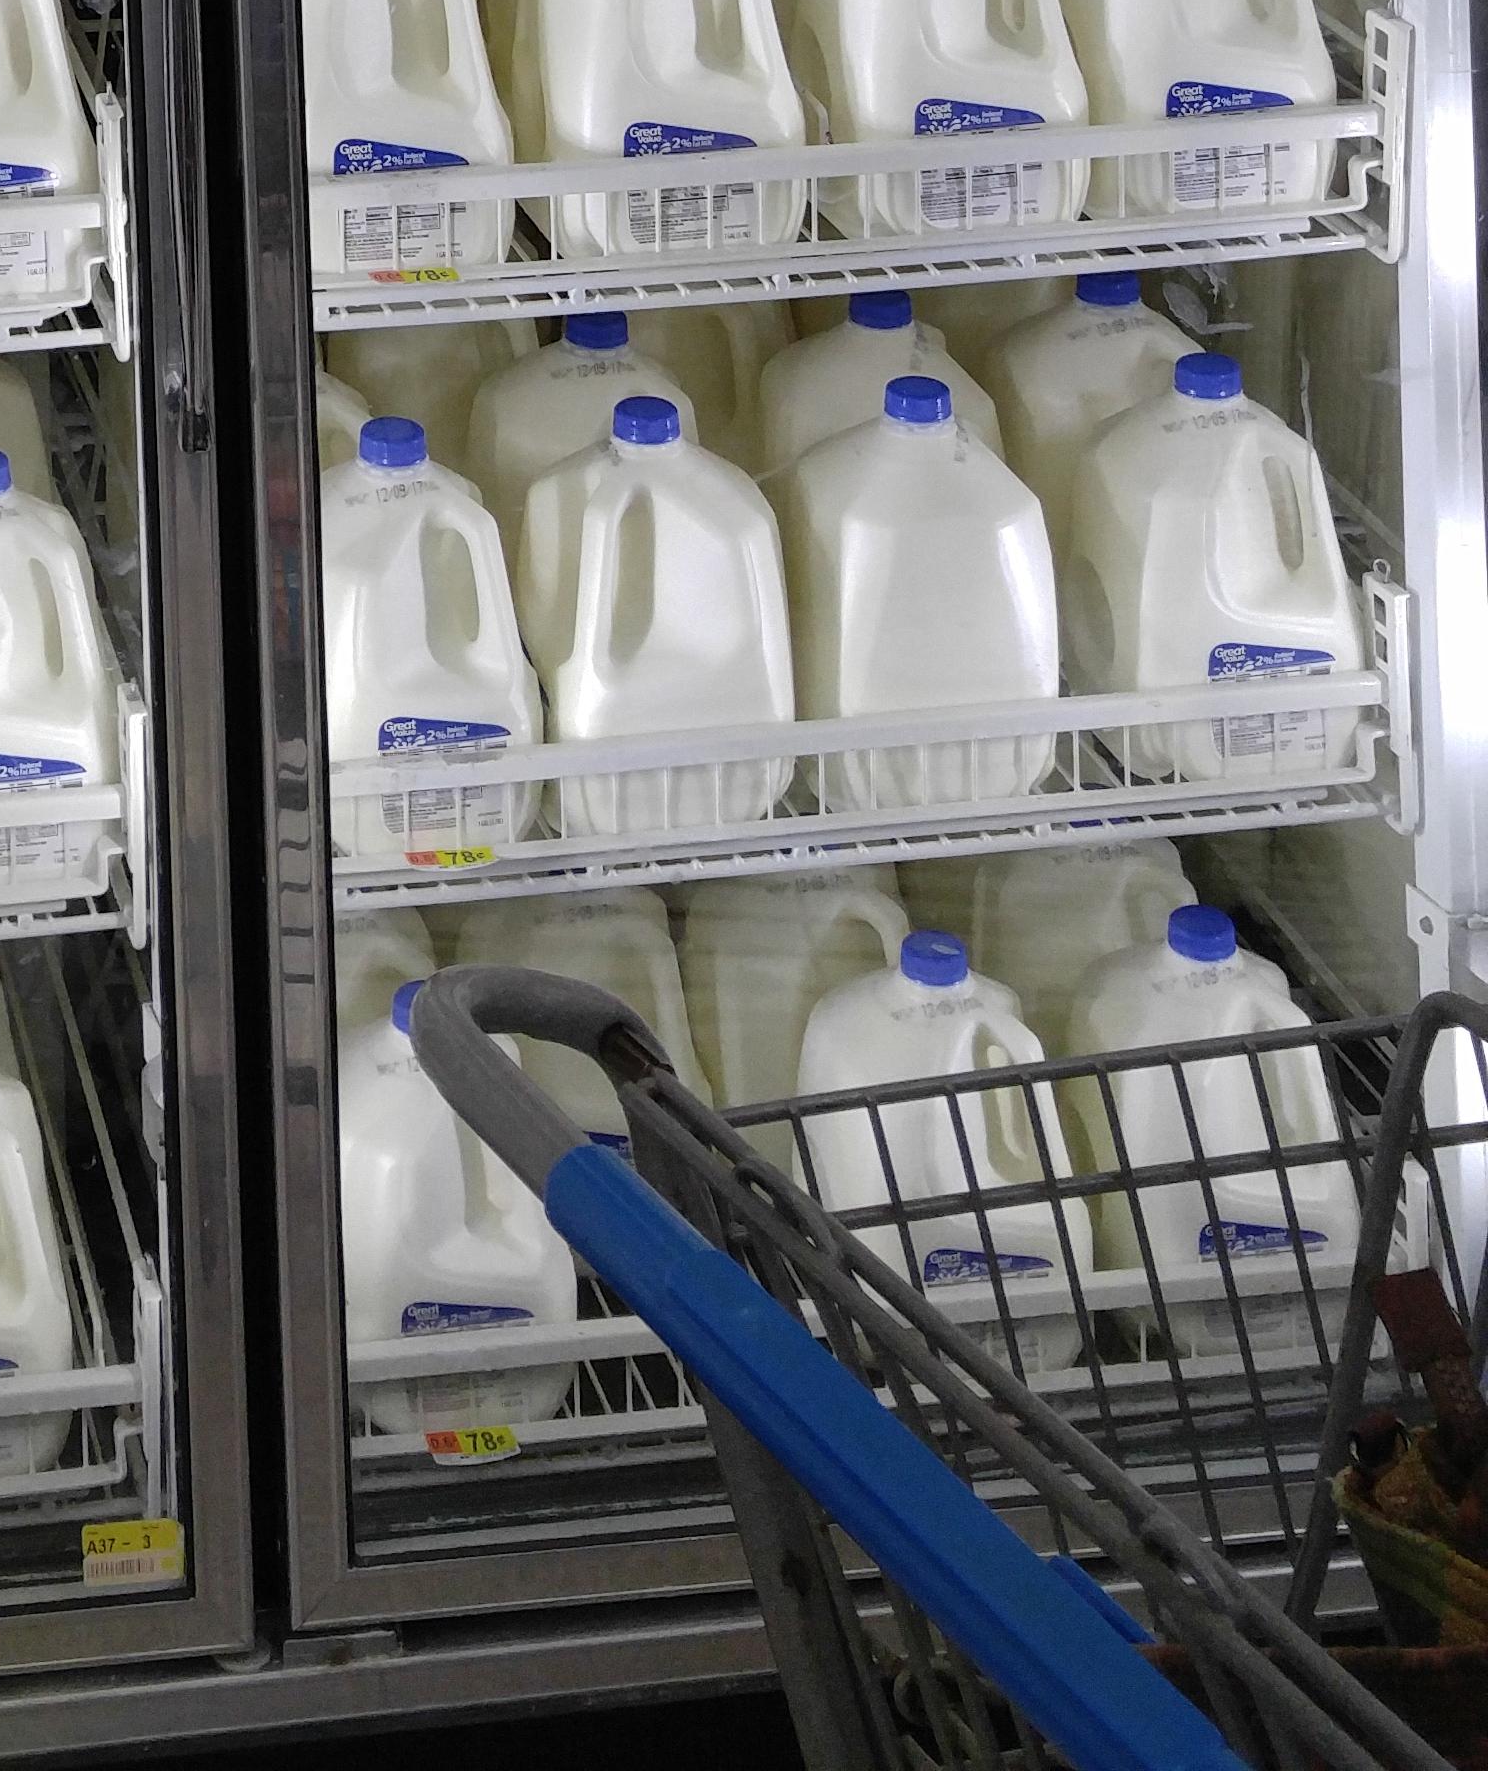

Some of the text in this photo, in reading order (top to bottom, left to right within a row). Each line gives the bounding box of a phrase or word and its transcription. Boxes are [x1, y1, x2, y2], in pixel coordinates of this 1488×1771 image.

[1171, 86, 1204, 96] Great
[1179, 93, 1203, 102] Value
[1212, 96, 1232, 108] 2%
[919, 104, 952, 114] Great
[927, 112, 952, 121] Value
[961, 114, 982, 126] 2%
[629, 127, 662, 138] Great
[638, 134, 663, 143] Value
[672, 137, 693, 149] 2%
[339, 144, 372, 155] Great
[347, 152, 372, 161] Value
[383, 154, 403, 166] 2%
[1214, 647, 1247, 658] Great
[383, 720, 416, 731] Great
[426, 730, 447, 741] 2%
[86, 1537, 117, 1555] A37
